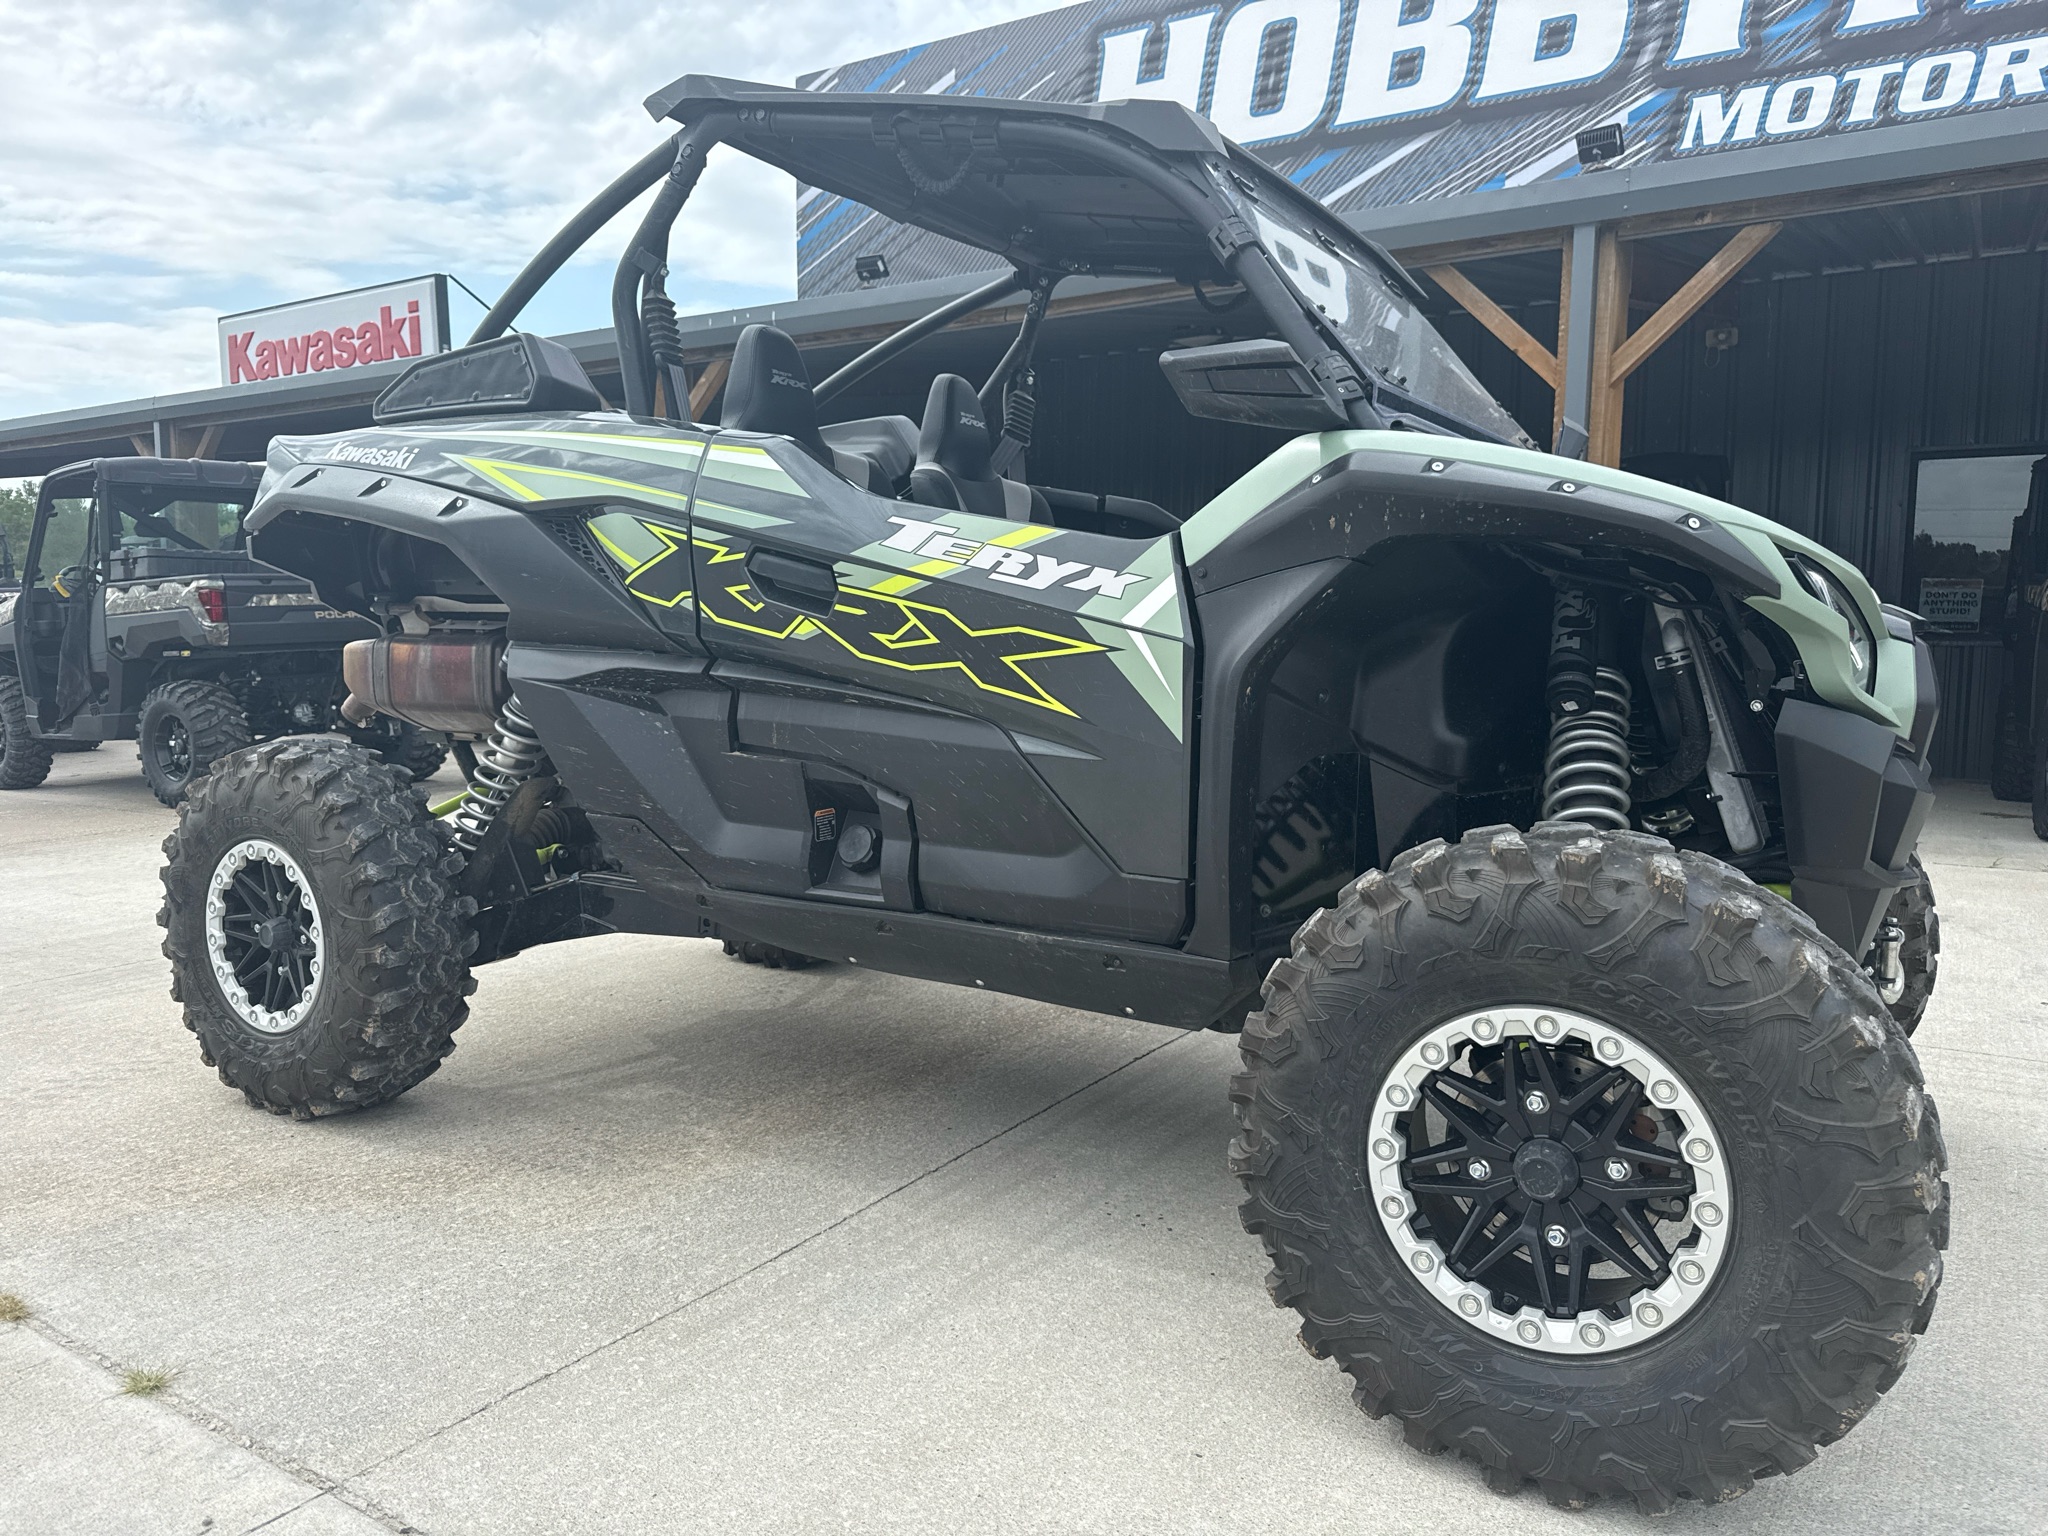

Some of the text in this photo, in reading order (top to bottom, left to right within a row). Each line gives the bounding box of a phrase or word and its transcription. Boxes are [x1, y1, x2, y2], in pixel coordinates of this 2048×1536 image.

[1097, 0, 2048, 144] HOBB
[227, 299, 423, 384] Kawasaki
[324, 441, 420, 470] Kawasaki
[1925, 591, 1958, 599] DON'T
[1929, 607, 1970, 615] STUPID!
